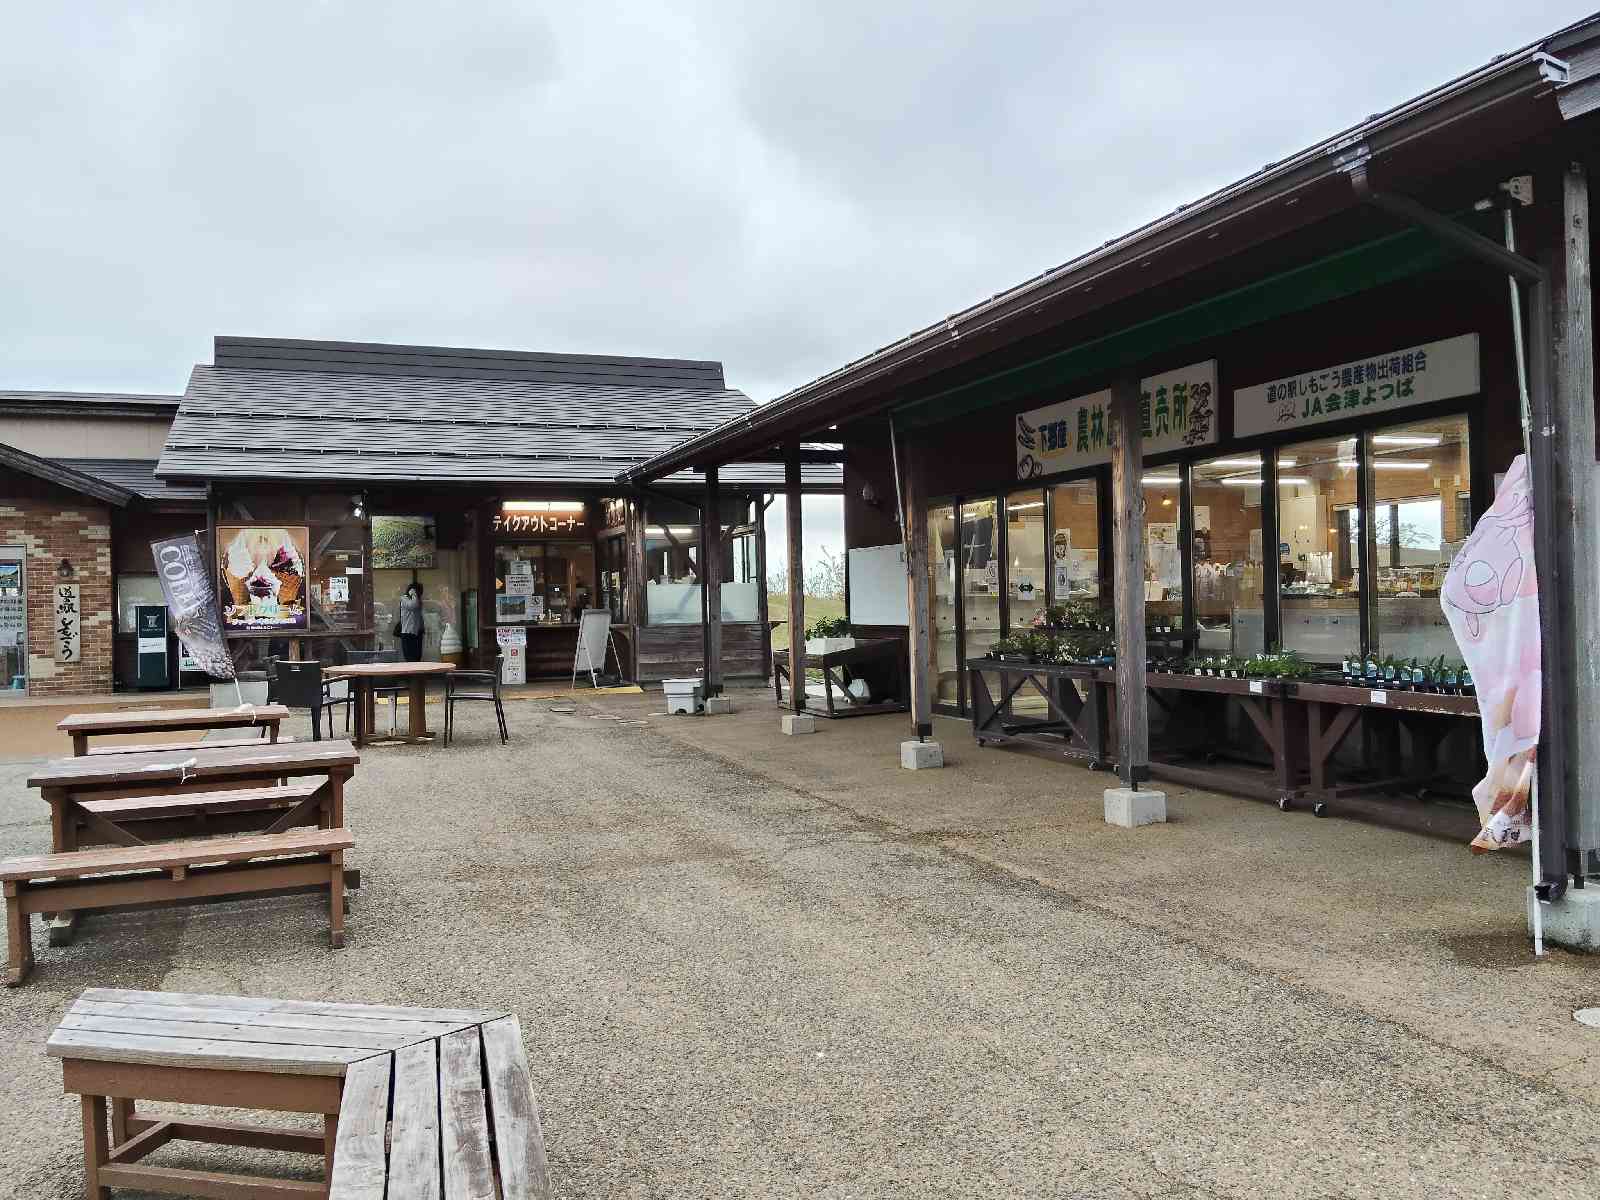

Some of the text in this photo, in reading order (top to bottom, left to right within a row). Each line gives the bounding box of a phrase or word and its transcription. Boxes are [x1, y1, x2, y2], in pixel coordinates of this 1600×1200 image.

[1302, 376, 1415, 418] JA会津よつば
[492, 514, 585, 533] テイクアウトコーナー
